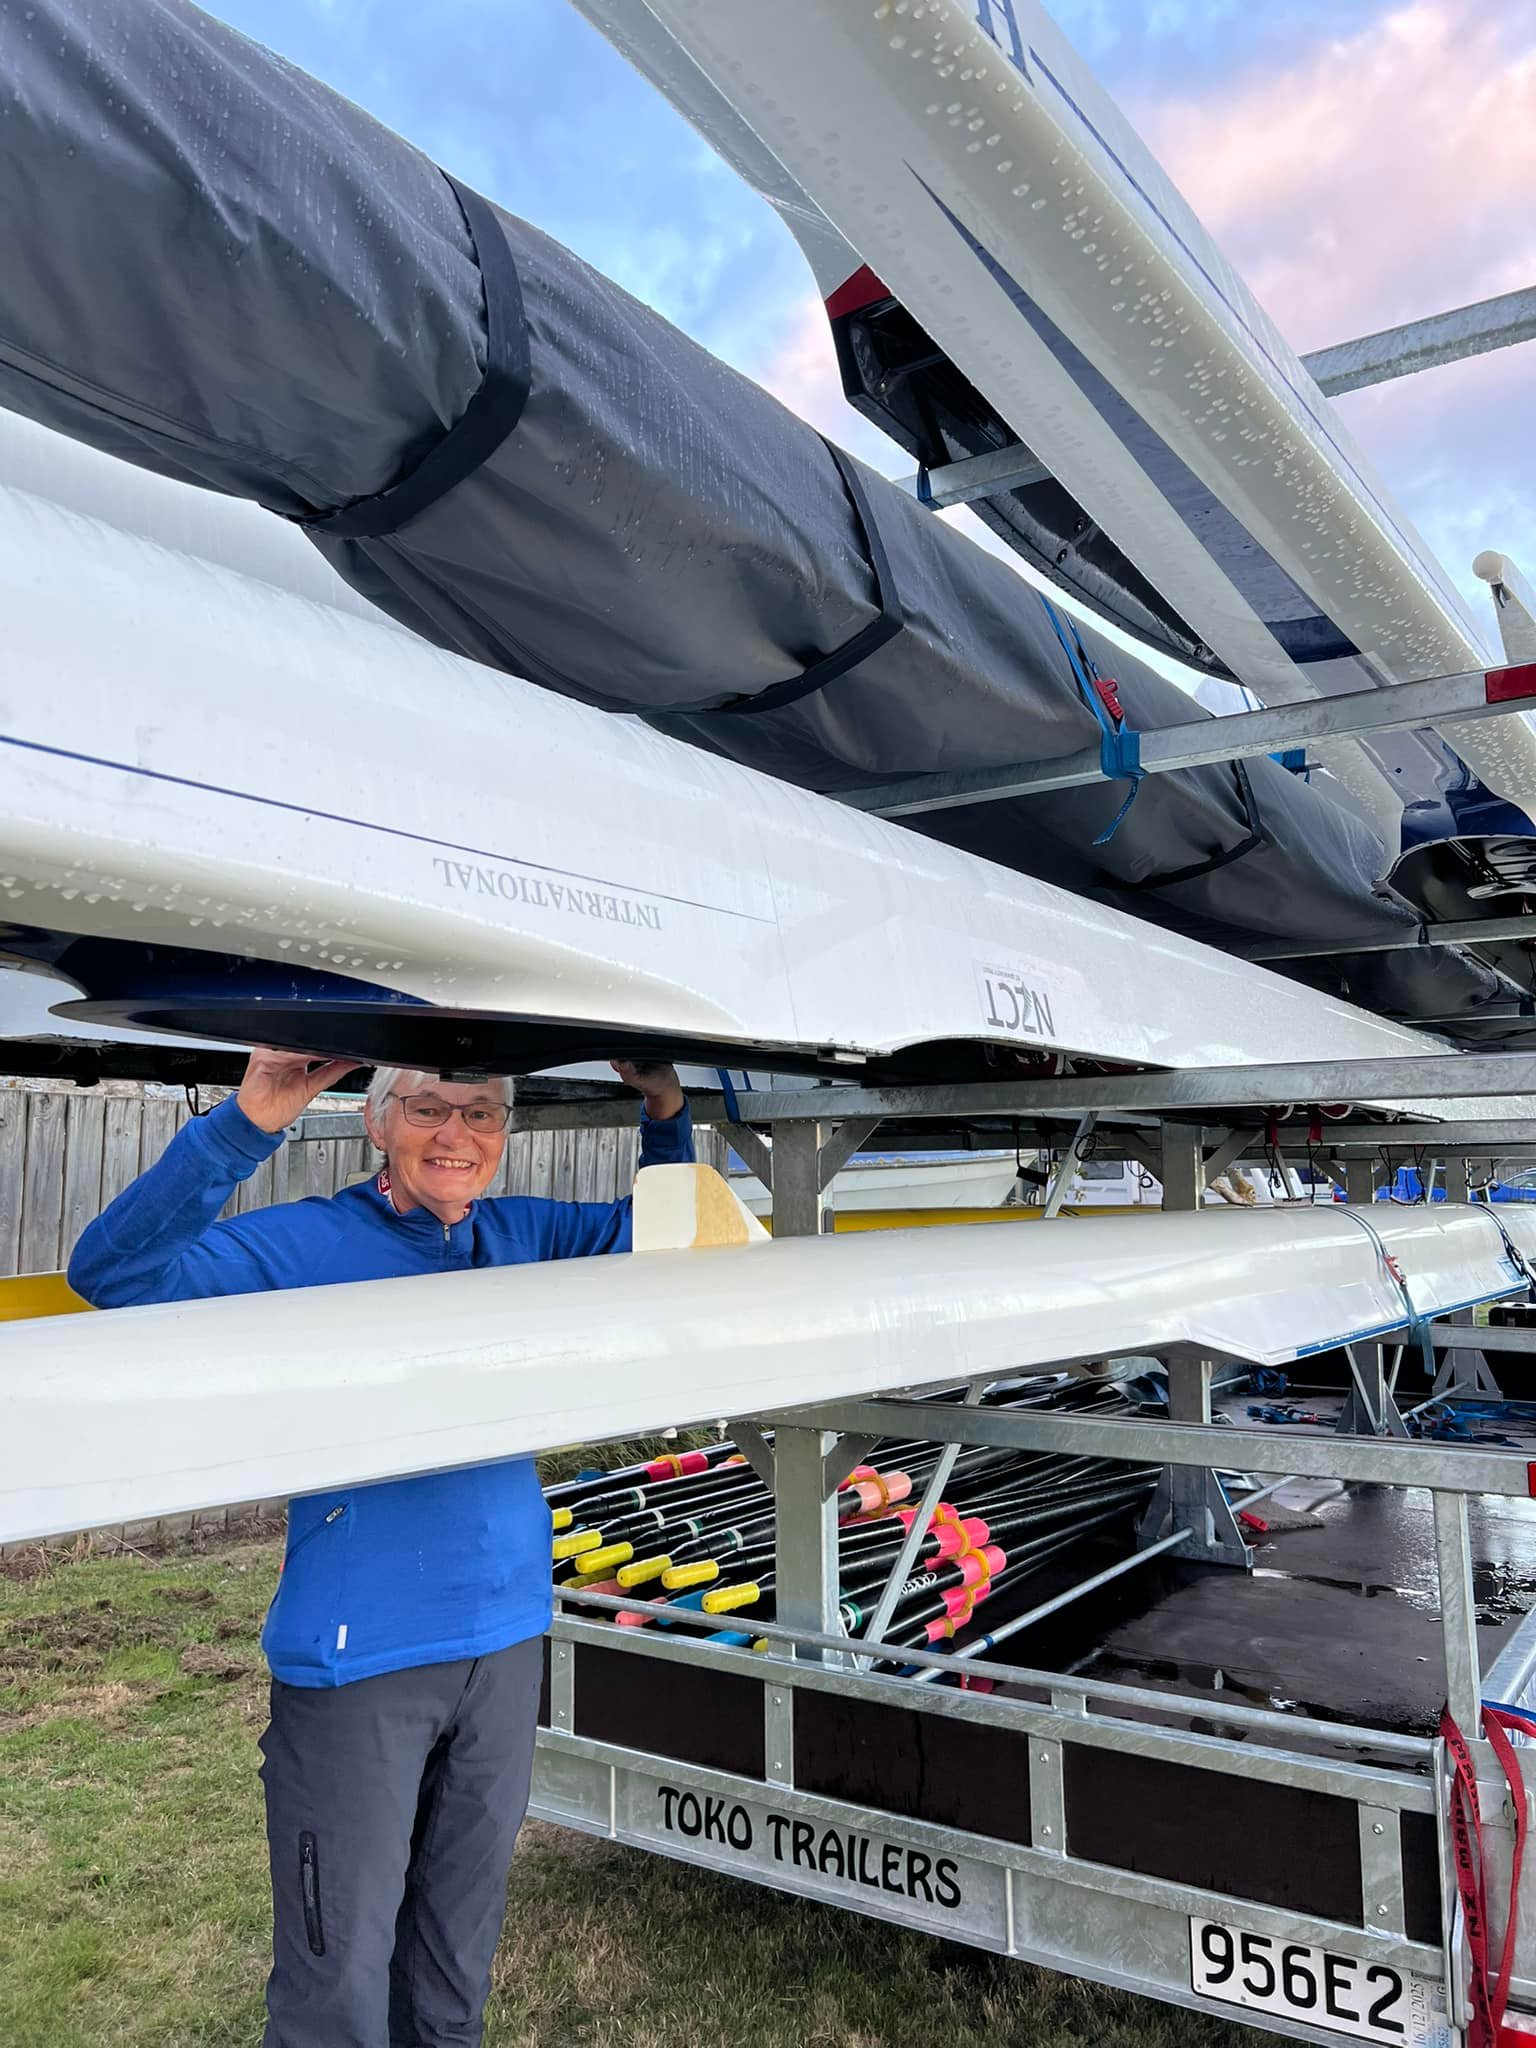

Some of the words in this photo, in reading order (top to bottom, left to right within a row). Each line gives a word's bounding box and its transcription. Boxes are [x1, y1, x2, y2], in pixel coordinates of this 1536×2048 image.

[432, 858, 663, 930] INTERNATIONAL
[984, 979, 1056, 1037] NZCT
[657, 1786, 753, 1850] TOKO
[766, 1814, 962, 1909] TRAILERS
[1201, 1923, 1404, 2034] 956E2
